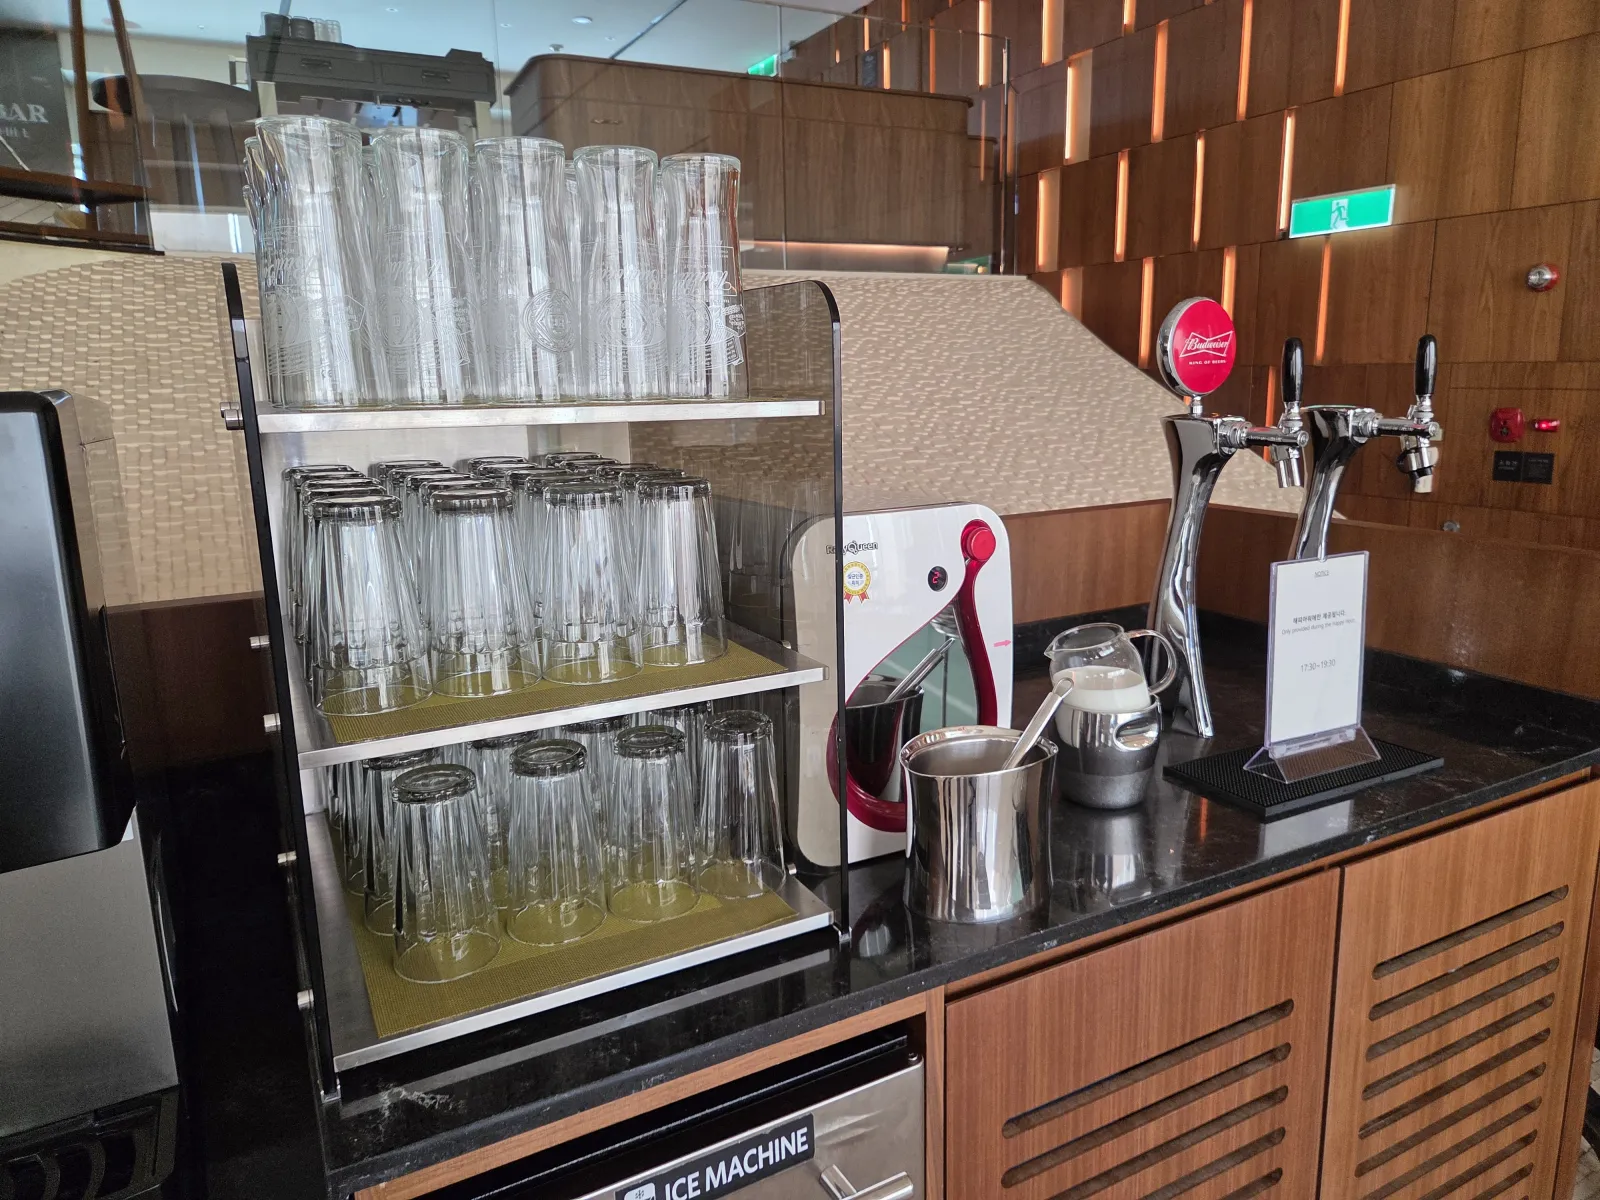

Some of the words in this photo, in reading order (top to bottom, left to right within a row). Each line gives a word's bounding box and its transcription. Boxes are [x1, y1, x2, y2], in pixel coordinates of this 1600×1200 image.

[1185, 338, 1228, 350] Budweiser
[932, 571, 941, 584] 2
[1281, 628, 1291, 636] Only
[1291, 624, 1310, 634] provided
[1311, 622, 1324, 631] during
[665, 1171, 700, 1200] ICE
[705, 1126, 809, 1192] MACHINE
